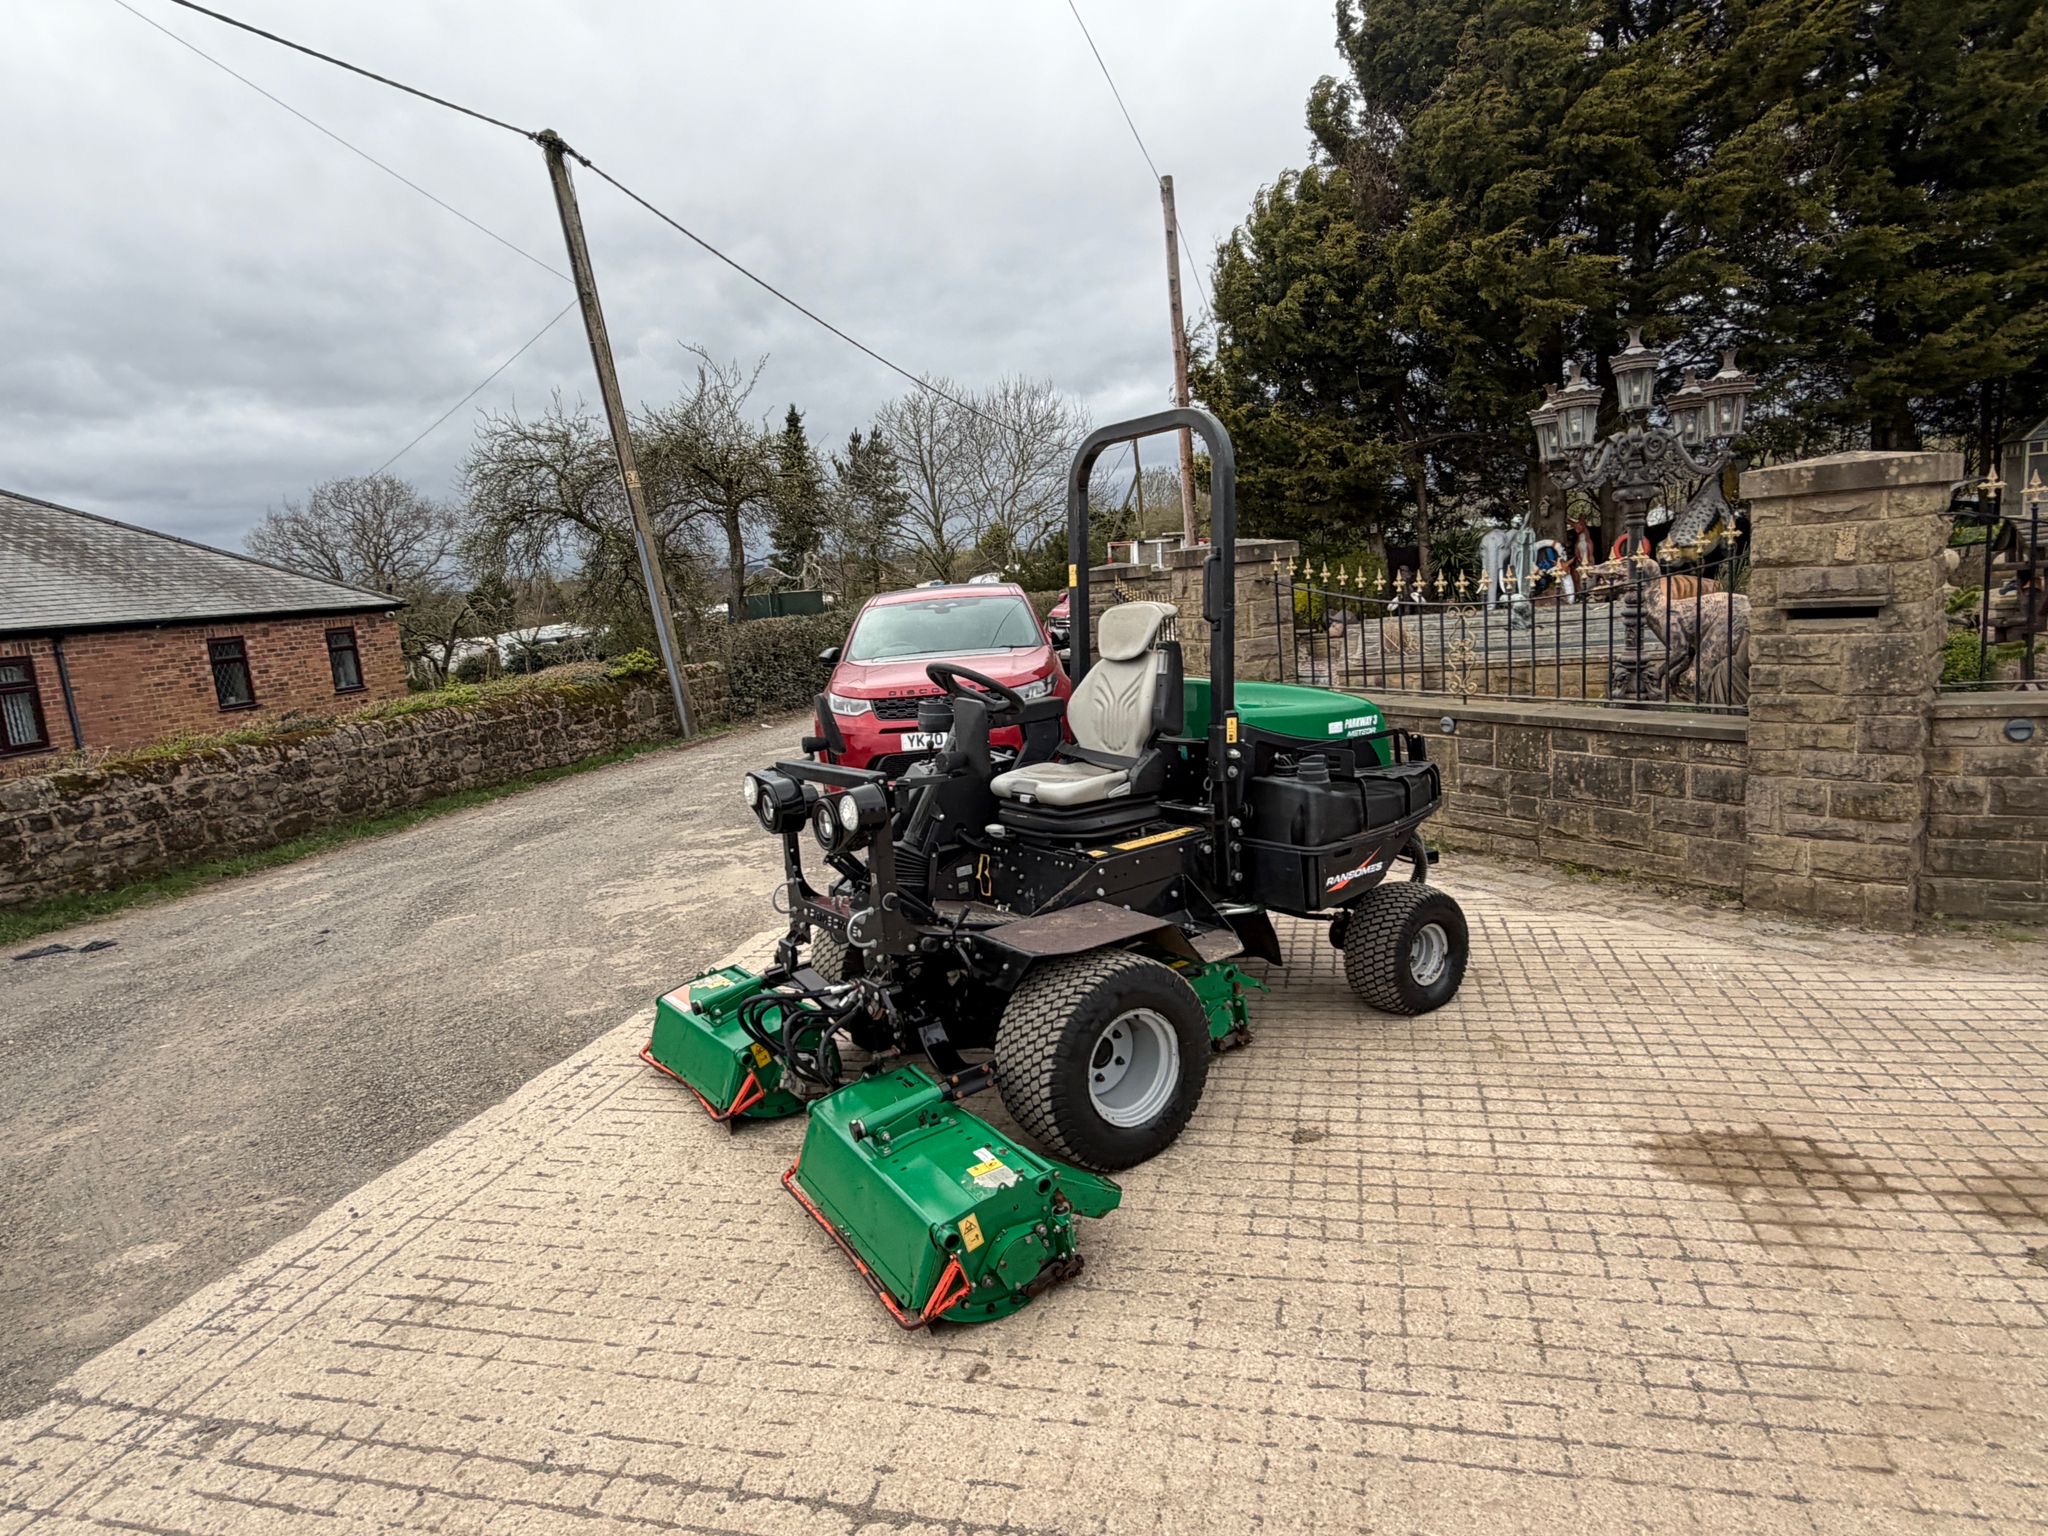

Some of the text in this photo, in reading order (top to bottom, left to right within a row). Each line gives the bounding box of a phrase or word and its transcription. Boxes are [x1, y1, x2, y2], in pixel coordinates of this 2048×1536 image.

[1345, 715, 1373, 729] PARKWAY
[1373, 714, 1378, 725] 3
[1326, 861, 1384, 887] RANSOMES
